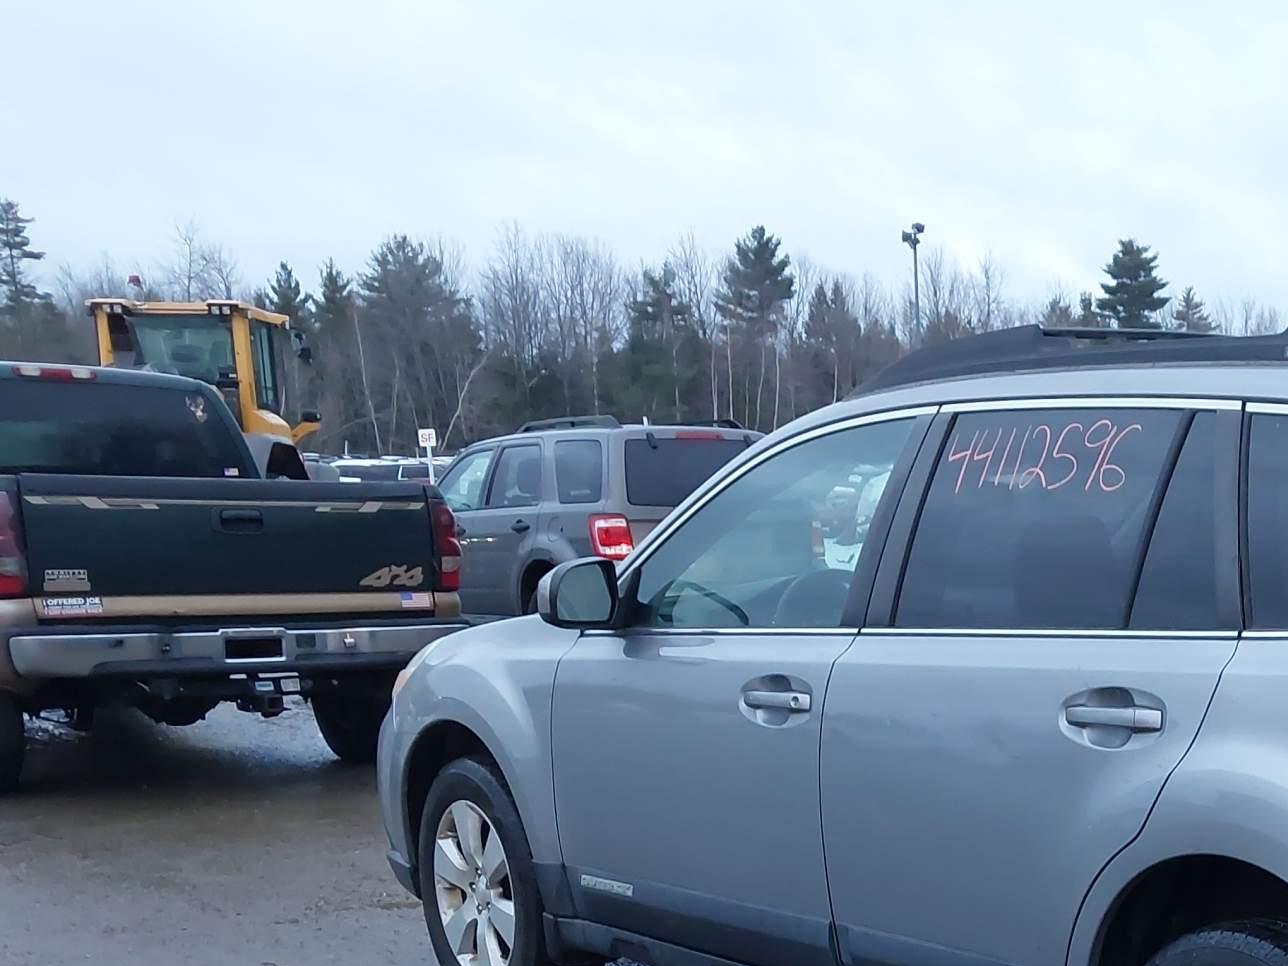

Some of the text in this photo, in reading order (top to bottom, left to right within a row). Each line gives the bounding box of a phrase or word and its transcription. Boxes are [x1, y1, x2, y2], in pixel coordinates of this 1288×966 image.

[948, 419, 1142, 495] 44112596
[47, 597, 85, 606] OFFERED
[86, 596, 101, 606] JOE
